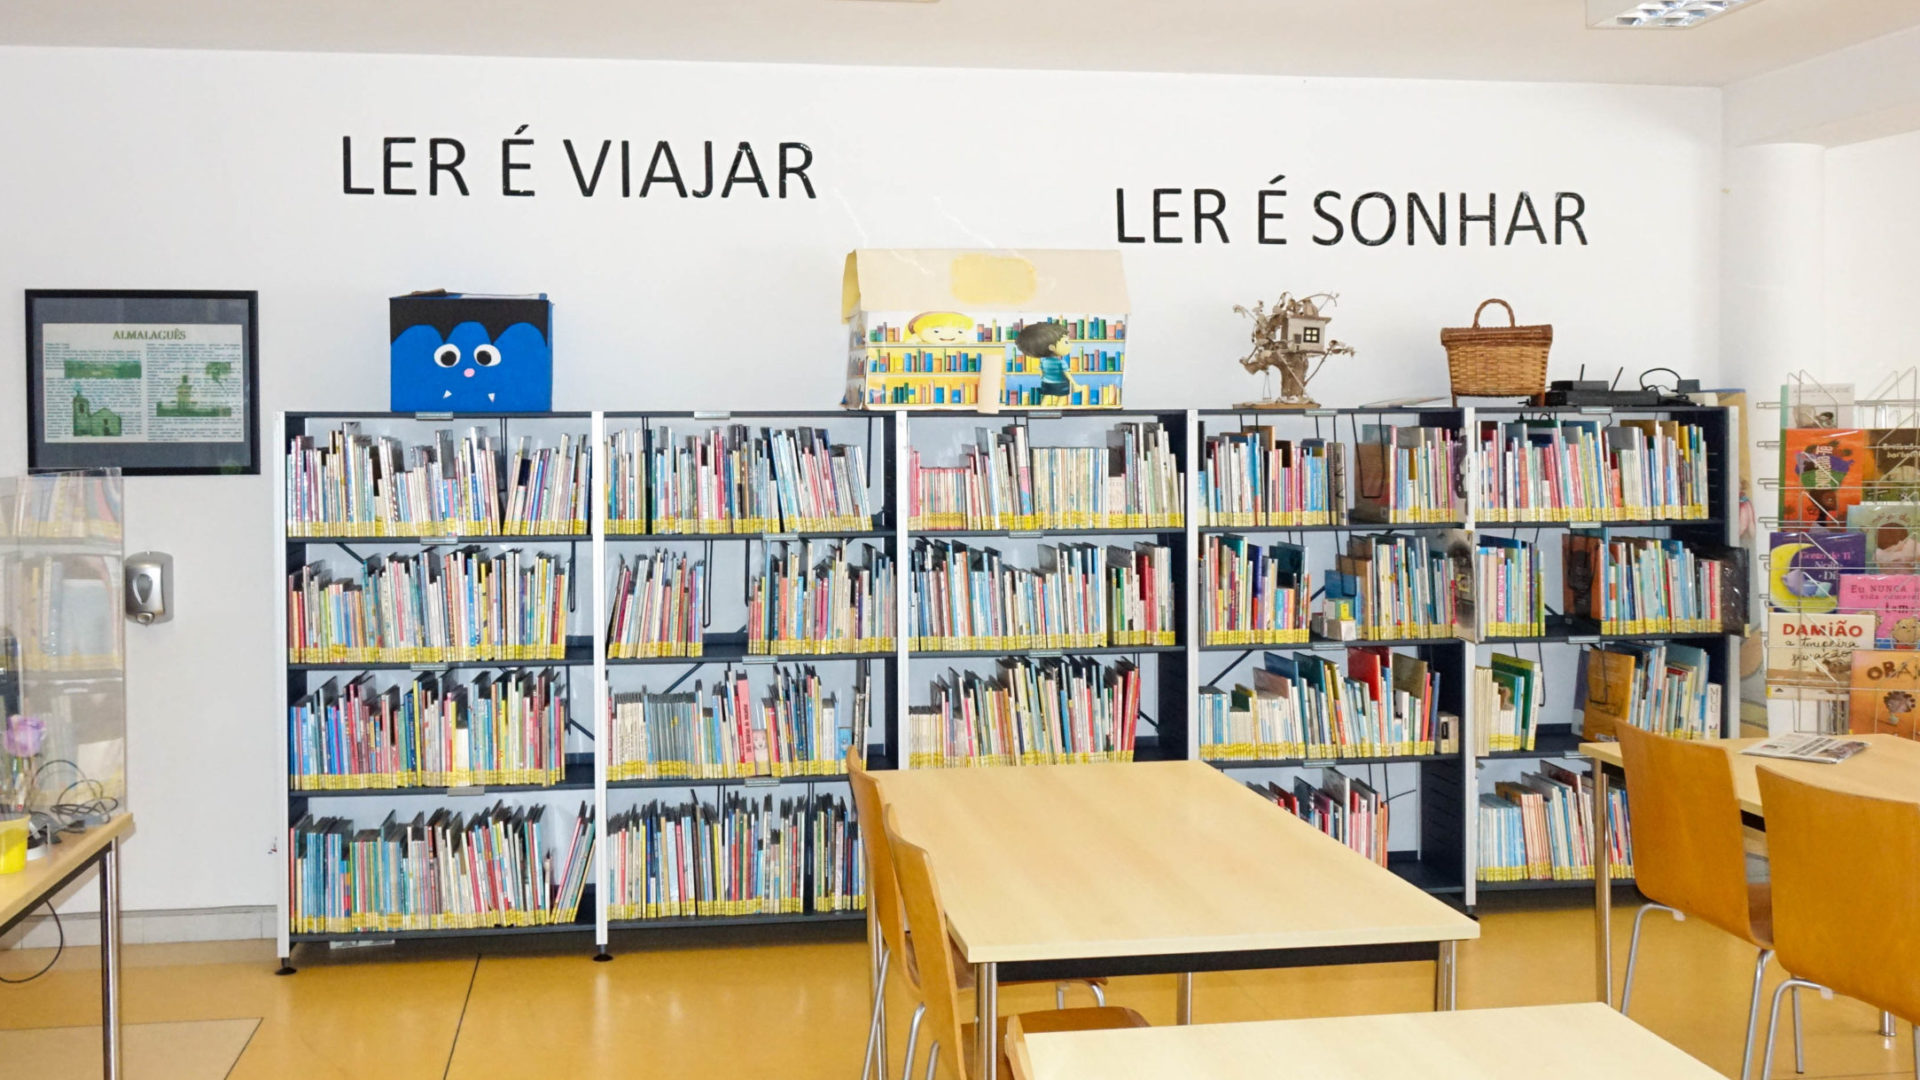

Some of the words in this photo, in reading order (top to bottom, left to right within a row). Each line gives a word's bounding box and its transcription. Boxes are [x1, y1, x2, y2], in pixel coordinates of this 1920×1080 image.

[343, 136, 470, 196] LER
[502, 124, 535, 197] É
[562, 139, 817, 199] VIAJAR
[1116, 188, 1230, 244] LER
[1258, 174, 1287, 245] É
[1312, 190, 1589, 247] SONHAR
[112, 327, 187, 341] ALMALAGUÊS
[1850, 584, 1865, 594] Eu
[1870, 584, 1907, 593] NUNCA
